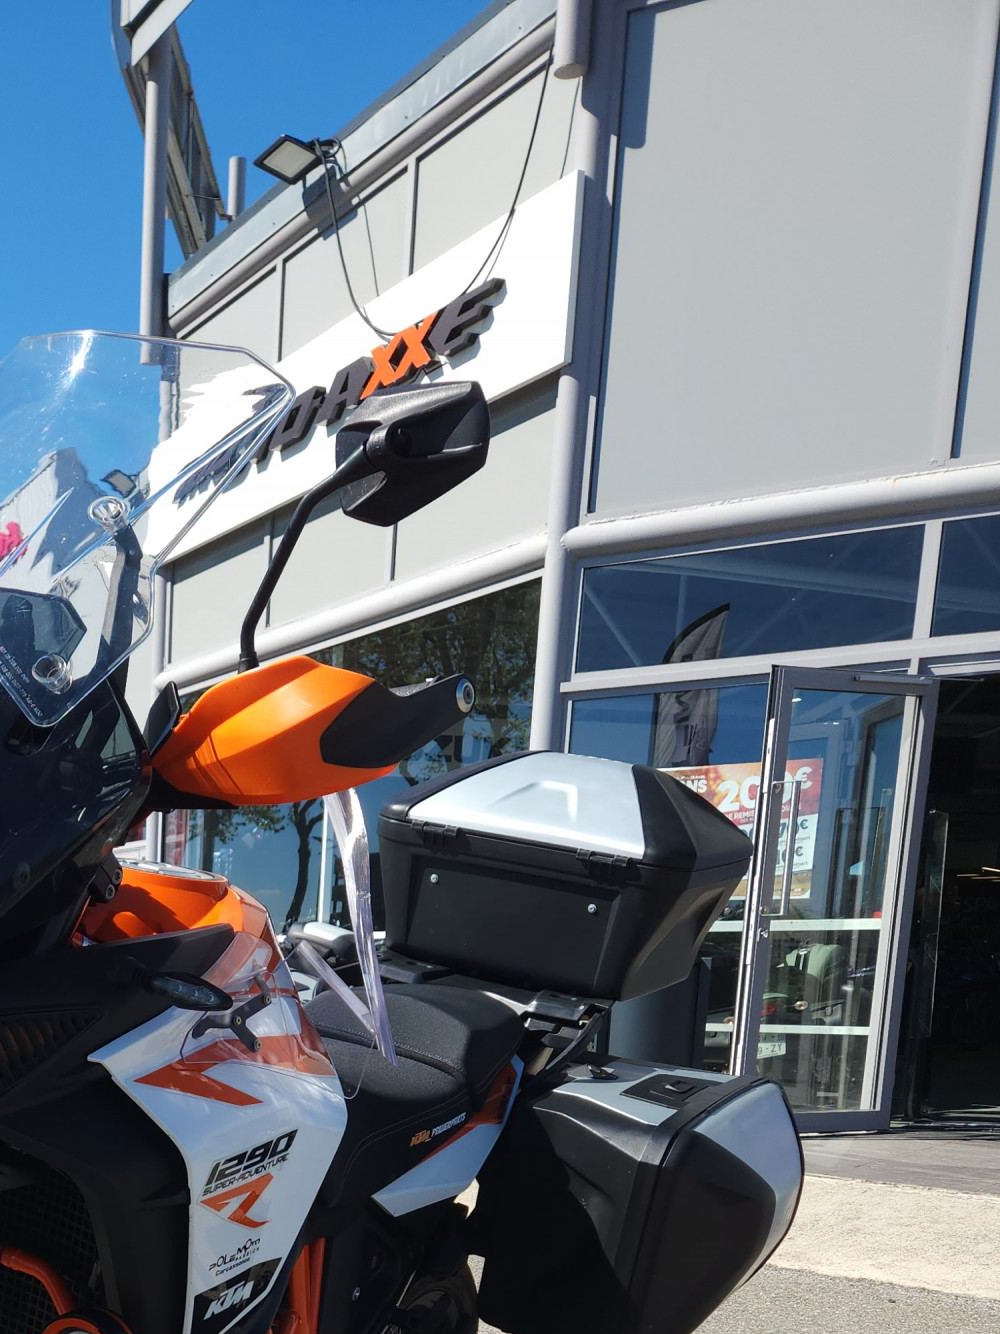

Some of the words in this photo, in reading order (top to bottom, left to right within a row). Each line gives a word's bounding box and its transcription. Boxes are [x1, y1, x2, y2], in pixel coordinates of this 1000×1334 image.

[205, 1129, 299, 1187] 1290
[410, 1130, 431, 1147] KTM
[203, 1280, 255, 1321] KTM
